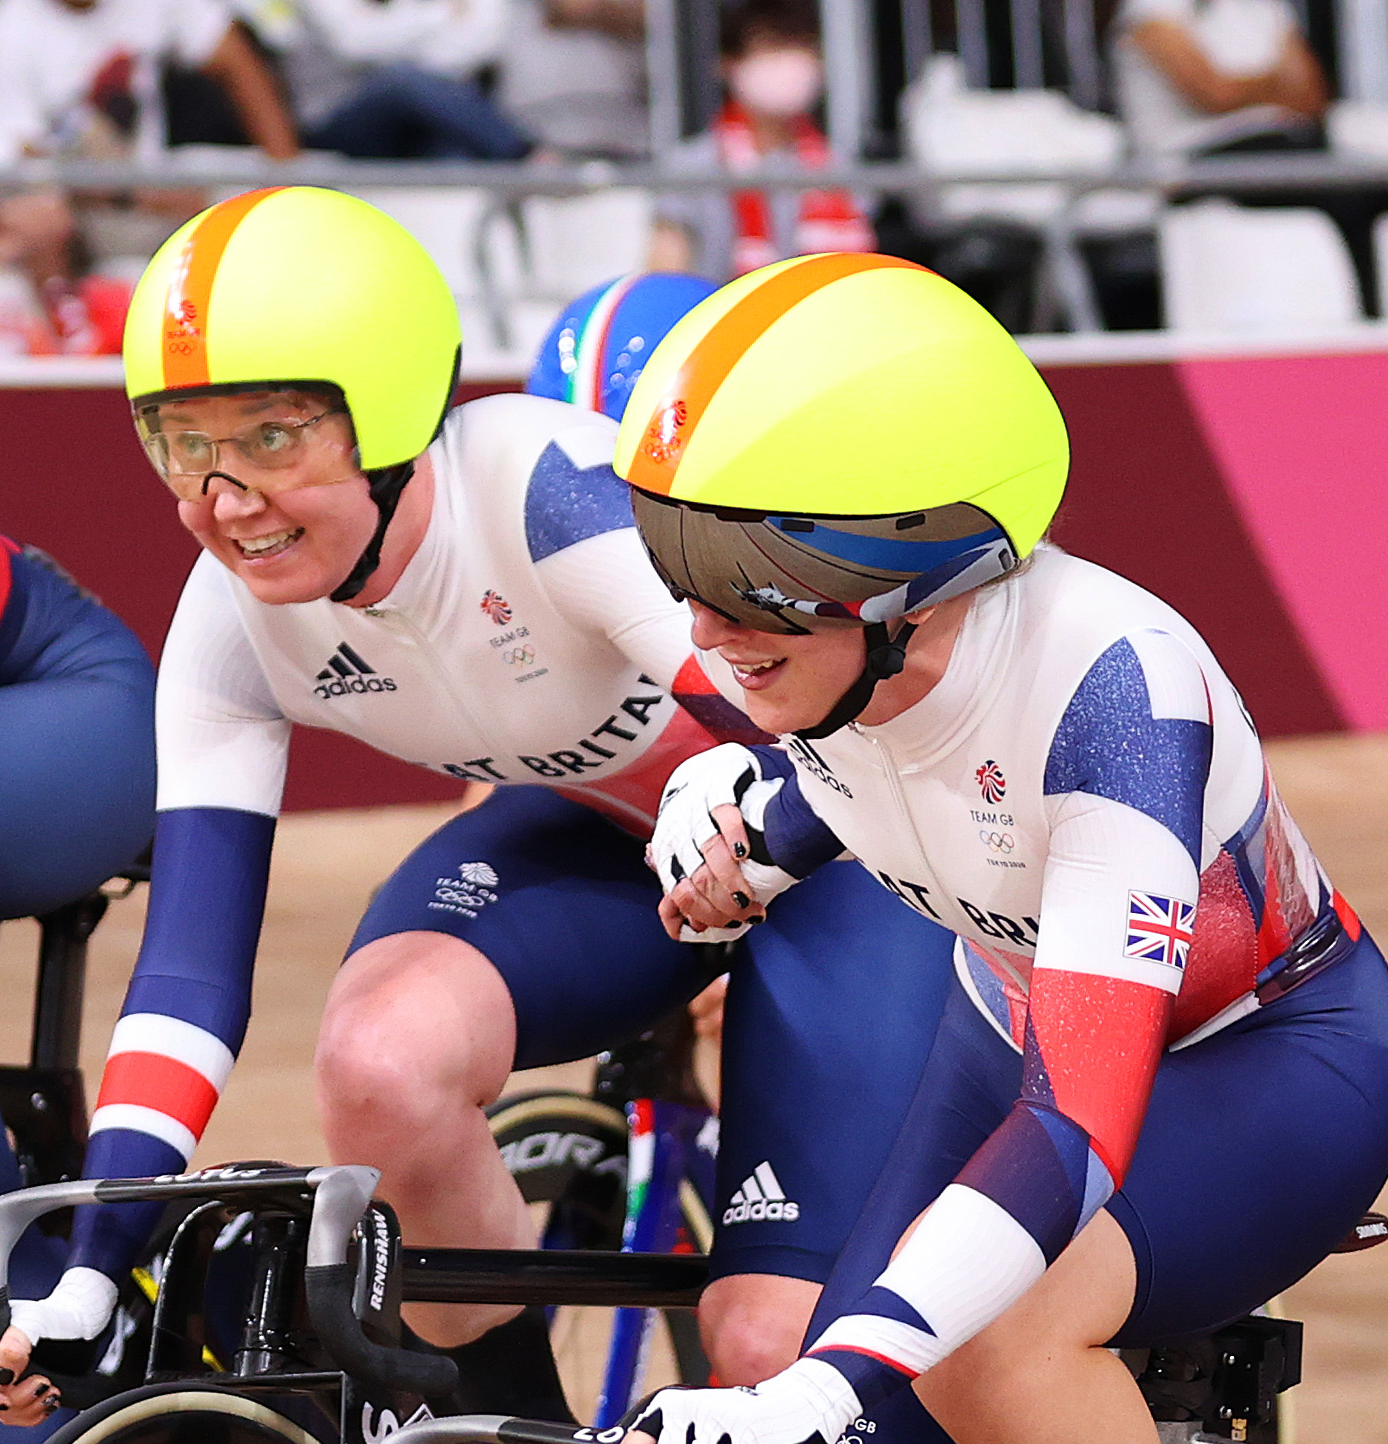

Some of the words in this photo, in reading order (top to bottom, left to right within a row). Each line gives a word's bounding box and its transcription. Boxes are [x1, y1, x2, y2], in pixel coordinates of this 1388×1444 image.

[314, 674, 398, 700] adidas
[518, 673, 663, 777] BRITA
[970, 810, 998, 825] TEAM
[999, 813, 1014, 826] GB
[436, 877, 477, 894] TEAM
[722, 1198, 799, 1225] adidas
[370, 1208, 388, 1311] RENISHAW
[854, 1418, 877, 1434] GB
